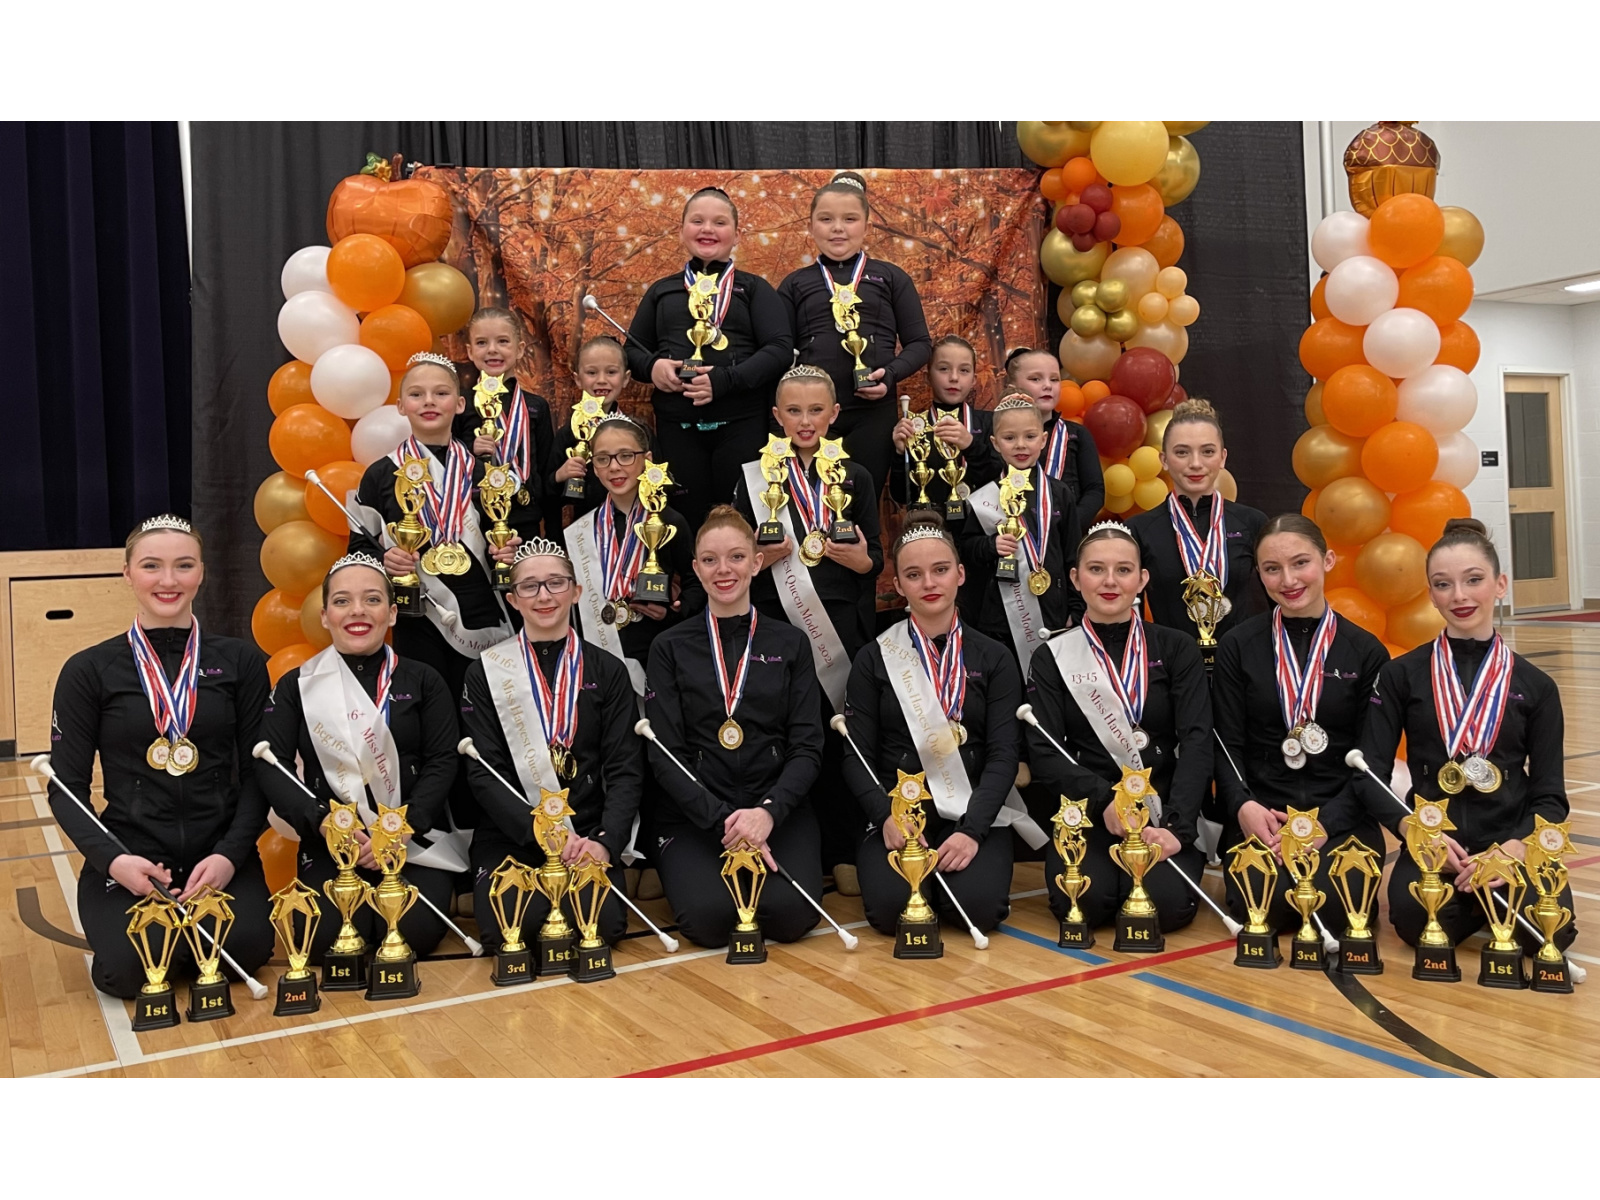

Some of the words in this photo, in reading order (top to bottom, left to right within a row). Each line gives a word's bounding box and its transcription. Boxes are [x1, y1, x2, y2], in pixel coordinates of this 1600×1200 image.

[569, 483, 583, 493] 3rd
[762, 525, 779, 535] 1st
[836, 525, 853, 533] 2nd
[999, 561, 1015, 571] 1st
[498, 574, 510, 584] 1s
[575, 533, 588, 556] Miss
[582, 555, 596, 593] Harvest
[589, 593, 602, 626] Queen
[597, 626, 609, 648] 202
[646, 580, 665, 592] 1st
[785, 574, 804, 609] Queen
[800, 608, 823, 640] Model
[817, 644, 834, 668] 2024
[1021, 612, 1036, 643] Model
[881, 636, 899, 653] Beg
[500, 658, 518, 669] 16+
[898, 648, 920, 667] 13-15
[1204, 655, 1215, 664] rd
[901, 669, 914, 693] Miss
[502, 679, 517, 706] Miss
[909, 692, 931, 732] Harvest
[1072, 672, 1098, 685] 13-15
[1088, 689, 1106, 715] Miss
[1104, 712, 1133, 753] Harvest
[511, 705, 531, 748] Harvest
[313, 722, 333, 746] Beg
[331, 740, 349, 753] 16+
[925, 732, 945, 770] Queen
[361, 727, 379, 754] Miss
[375, 752, 396, 795] Harvest
[524, 748, 542, 787] Queen
[941, 770, 955, 799] 2024
[905, 932, 928, 946] 1st
[1064, 930, 1082, 942] 3rd
[1126, 926, 1150, 941] 1st
[735, 941, 755, 953] 1st
[1243, 944, 1264, 957] 1st
[547, 949, 571, 962] 1st
[1297, 950, 1318, 961] 3rd
[1346, 951, 1369, 963] 2nd
[507, 963, 526, 974] 3rd
[588, 957, 607, 970] 1st
[1424, 958, 1448, 970] 2nd
[1488, 961, 1513, 975] 1st
[330, 965, 351, 977] 1st
[379, 971, 404, 984] 1st
[1539, 970, 1564, 982] 2nd
[200, 995, 224, 1010] 1st
[284, 991, 307, 1003] 2nd
[145, 1003, 168, 1017] 1st
